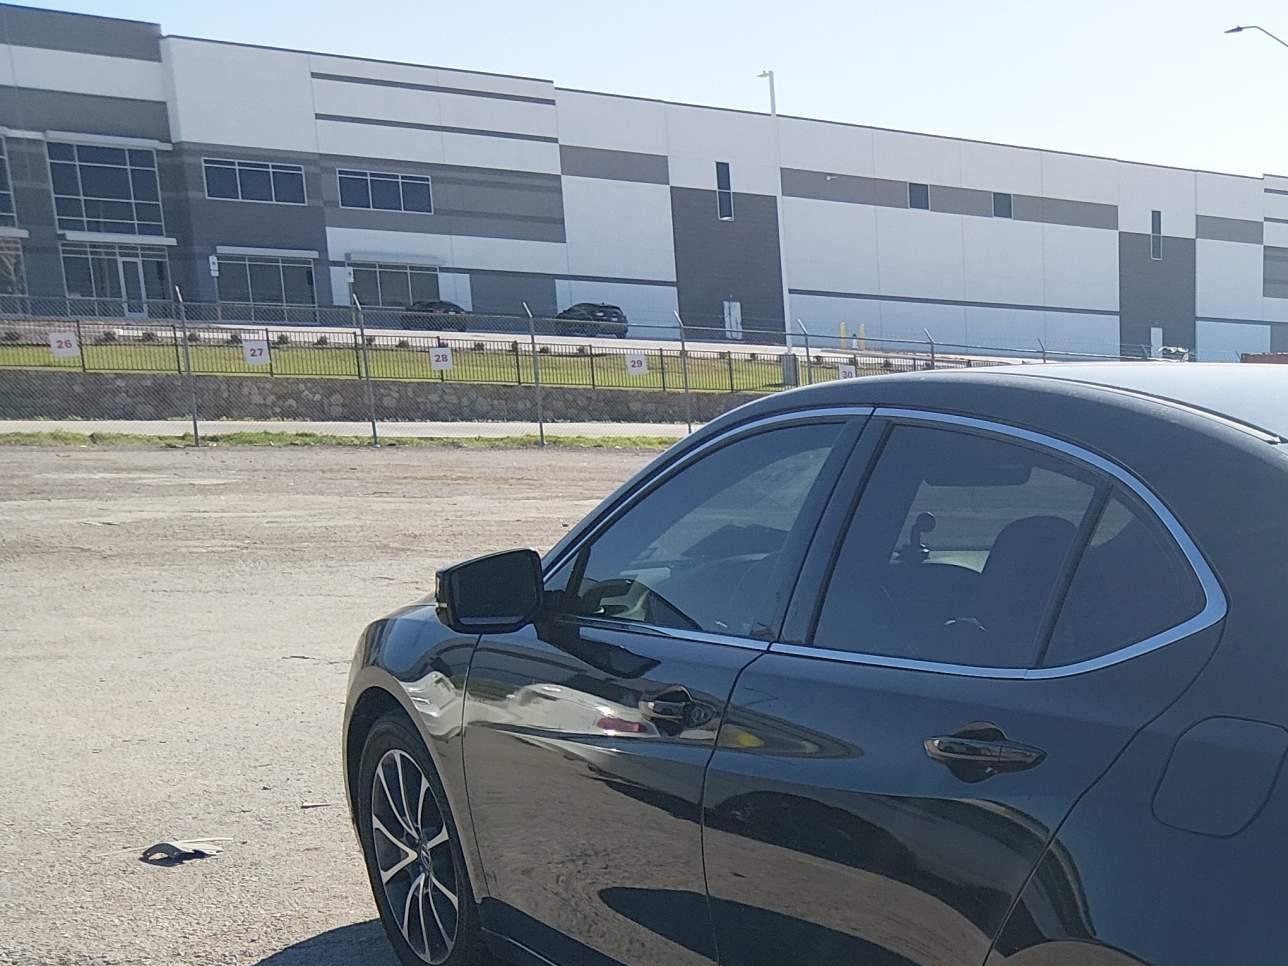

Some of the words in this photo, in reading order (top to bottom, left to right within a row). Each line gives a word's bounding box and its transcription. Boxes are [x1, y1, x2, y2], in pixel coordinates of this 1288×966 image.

[56, 340, 72, 349] 26
[250, 348, 263, 357] 27
[434, 354, 449, 363] 28
[631, 360, 643, 368] 29
